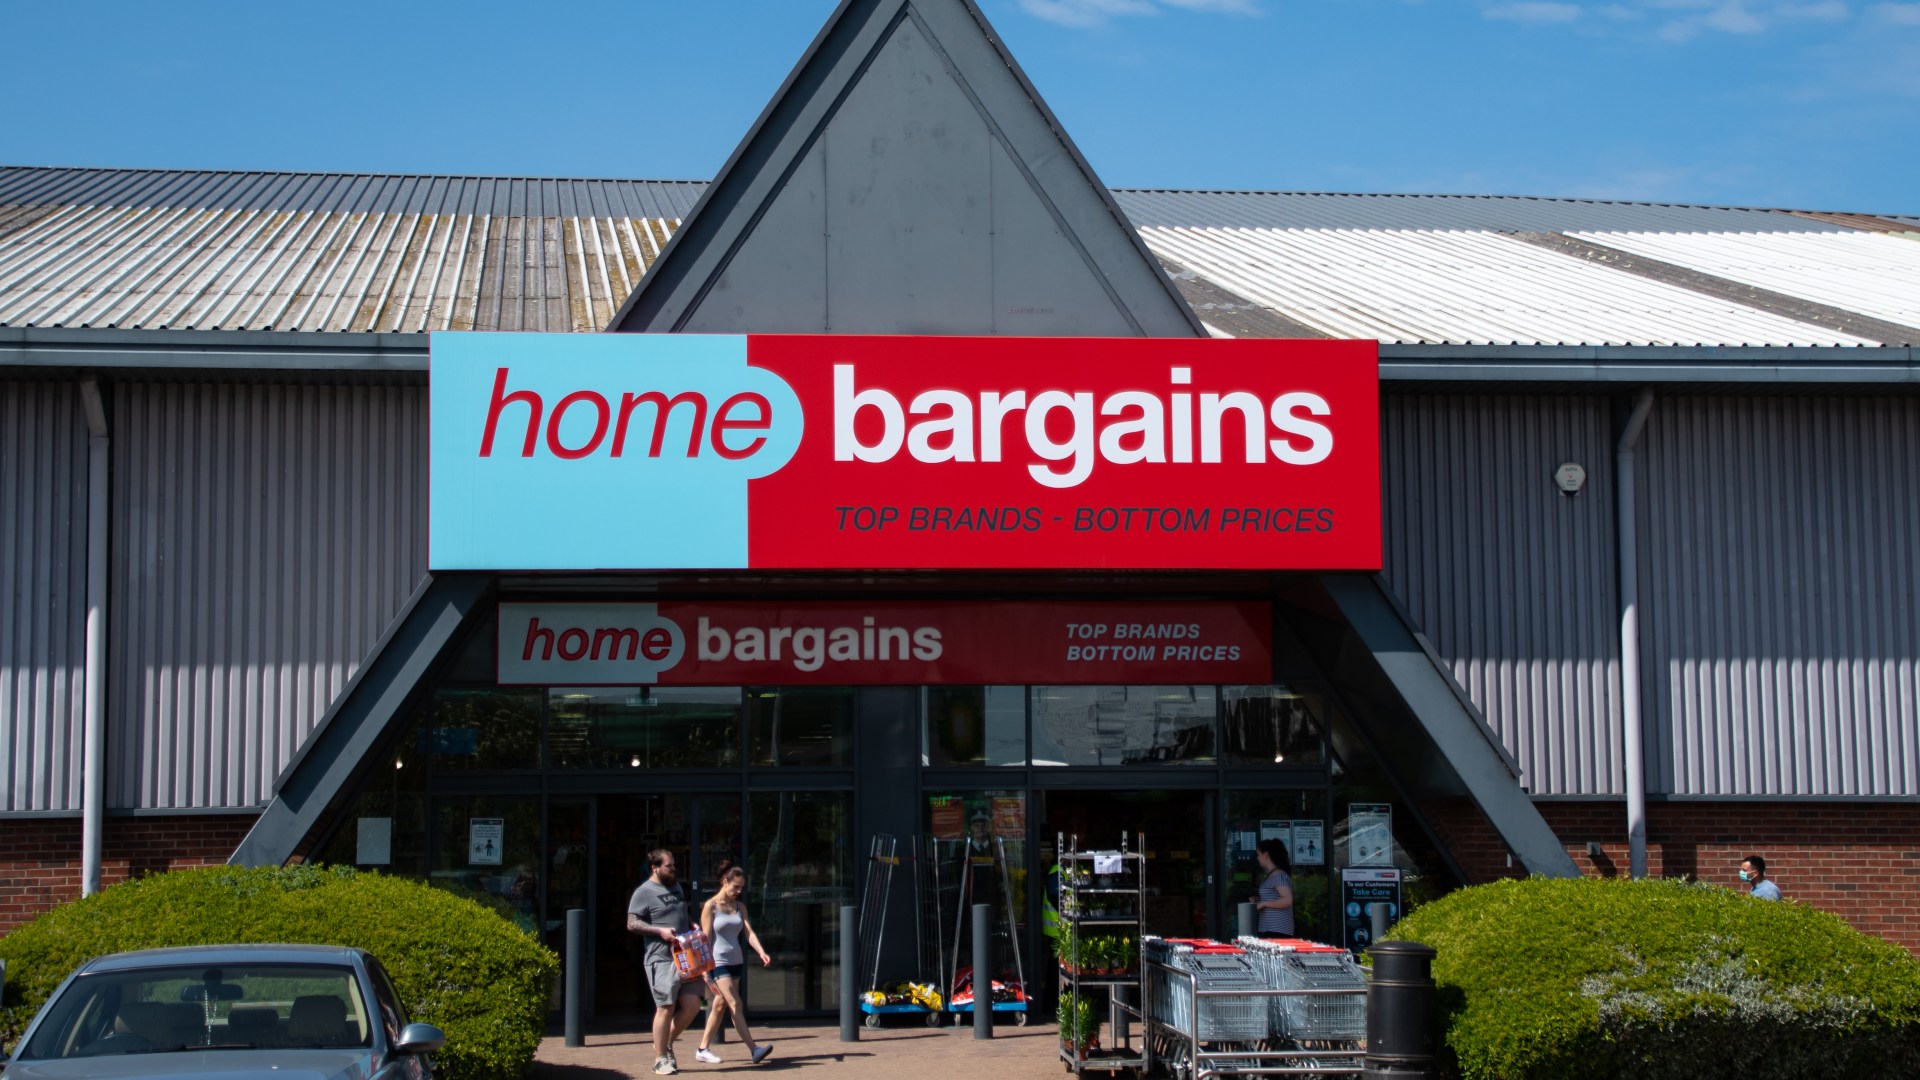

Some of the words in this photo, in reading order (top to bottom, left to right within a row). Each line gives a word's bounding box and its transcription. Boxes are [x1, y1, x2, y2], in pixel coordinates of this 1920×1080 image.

[479, 366, 774, 462] home
[832, 362, 1334, 489] bargains
[836, 506, 900, 531] TOP
[908, 507, 1042, 532] BRANDS
[1074, 507, 1211, 532] BOTTOM
[1220, 508, 1334, 533] PRICES
[521, 616, 673, 662] home
[697, 616, 943, 672] bargains
[1066, 623, 1108, 639] TOP
[1114, 623, 1200, 639] BRANDS
[1066, 645, 1156, 661] BOTTOM
[1162, 645, 1241, 661] PRICES
